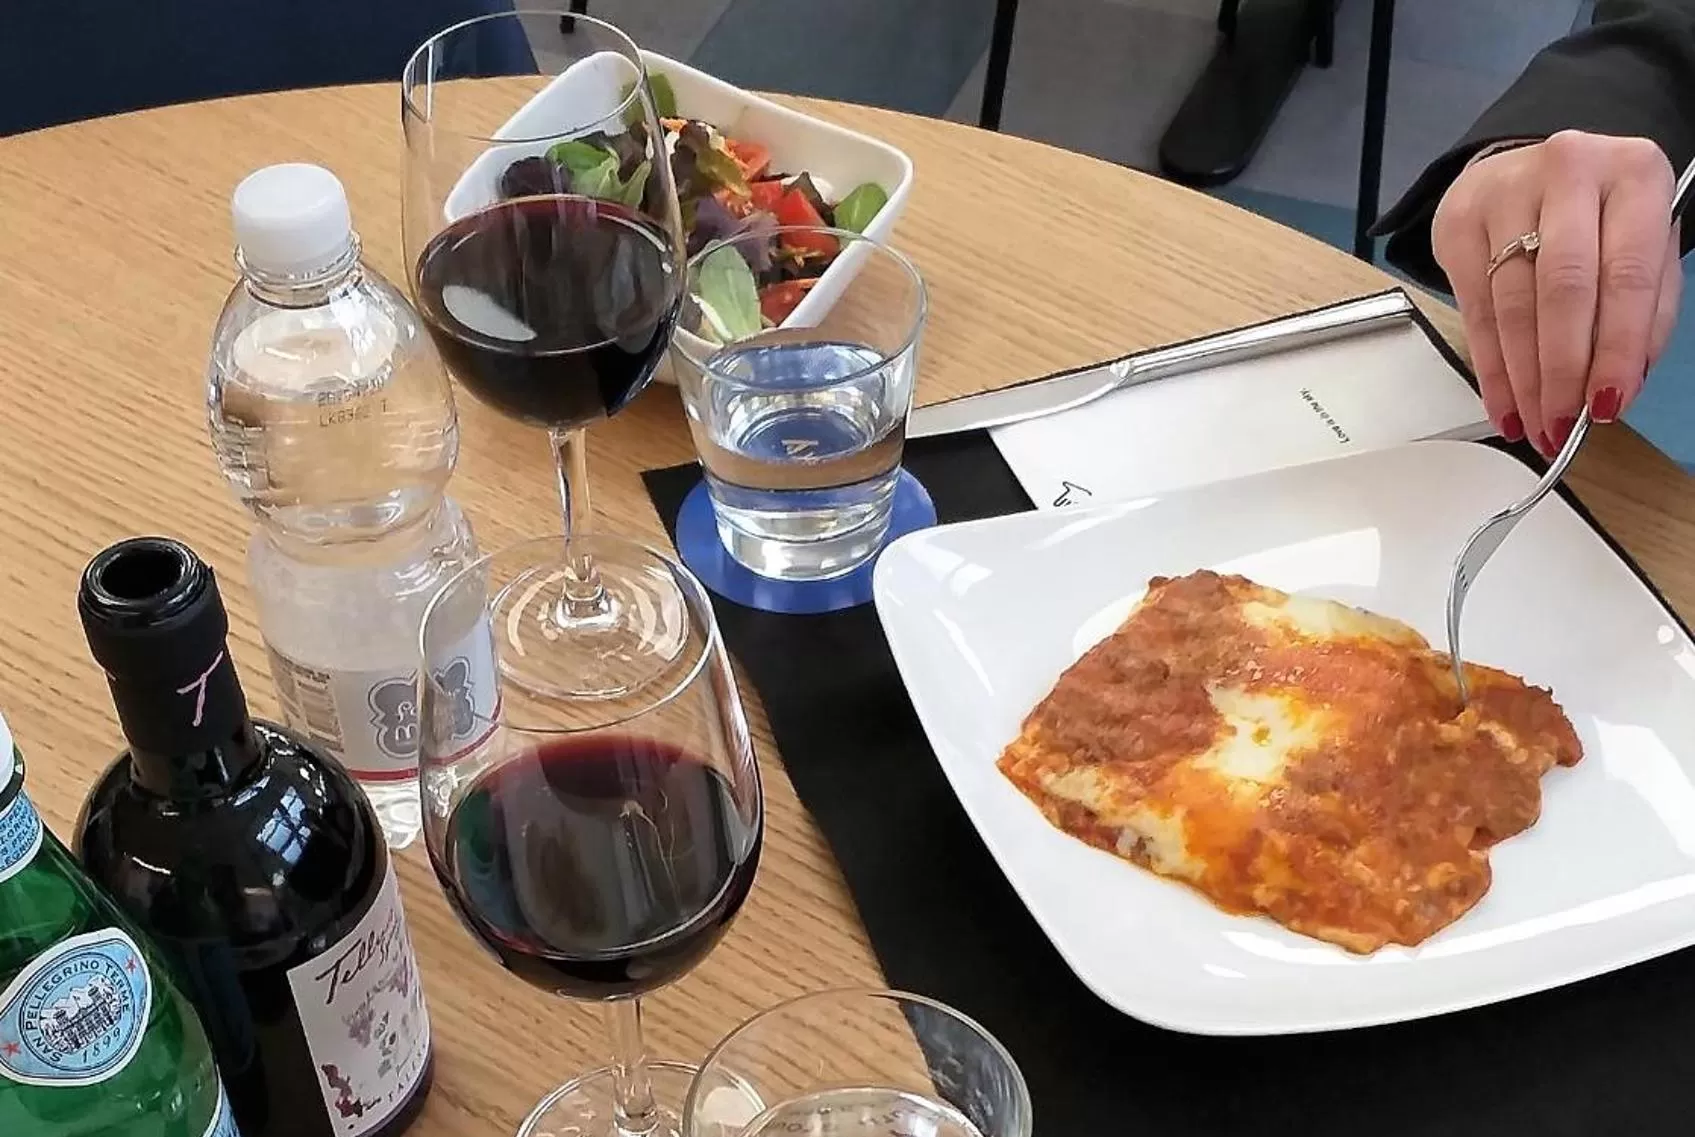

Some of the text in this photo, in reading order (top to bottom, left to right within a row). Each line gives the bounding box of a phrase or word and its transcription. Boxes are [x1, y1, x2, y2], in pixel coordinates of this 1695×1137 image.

[25, 960, 130, 1062] SAN PELLEGRINO TERME
[83, 1028, 121, 1063] 1899
